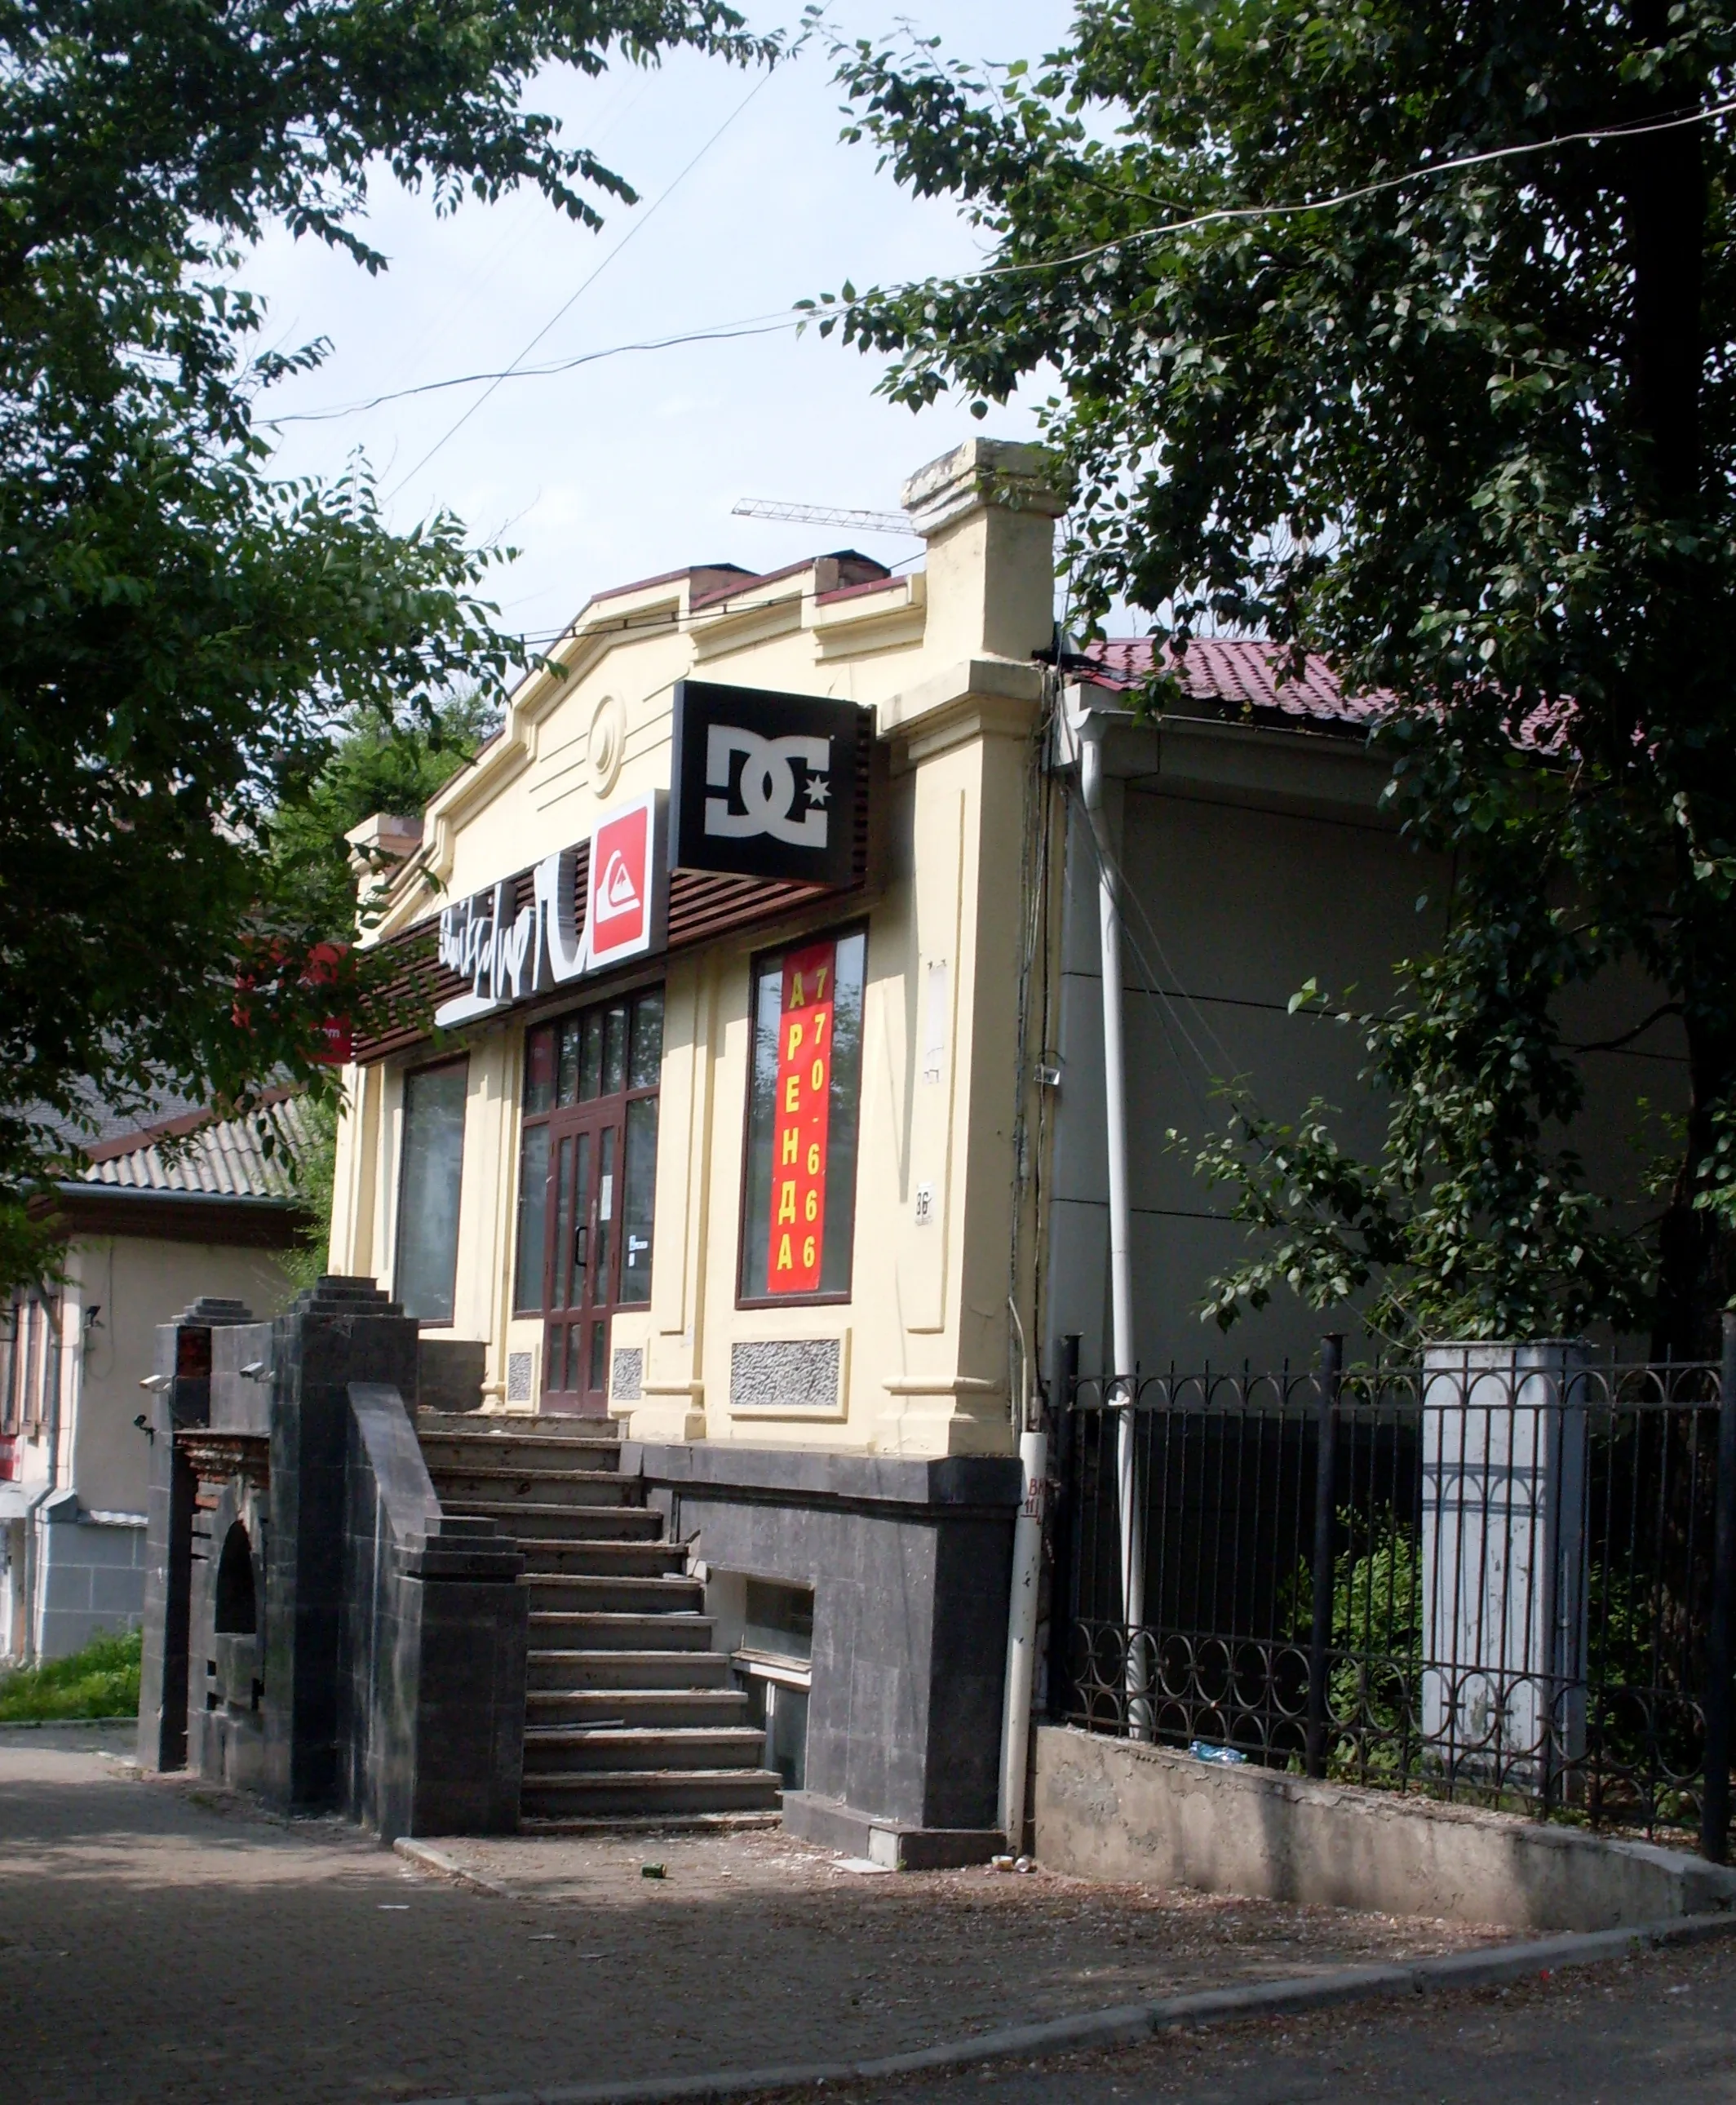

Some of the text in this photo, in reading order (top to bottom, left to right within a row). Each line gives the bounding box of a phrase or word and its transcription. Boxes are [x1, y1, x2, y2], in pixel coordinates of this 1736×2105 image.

[704, 724, 830, 849] DC
[776, 971, 804, 1272] АРЕНДА
[801, 966, 829, 1270] 770-666
